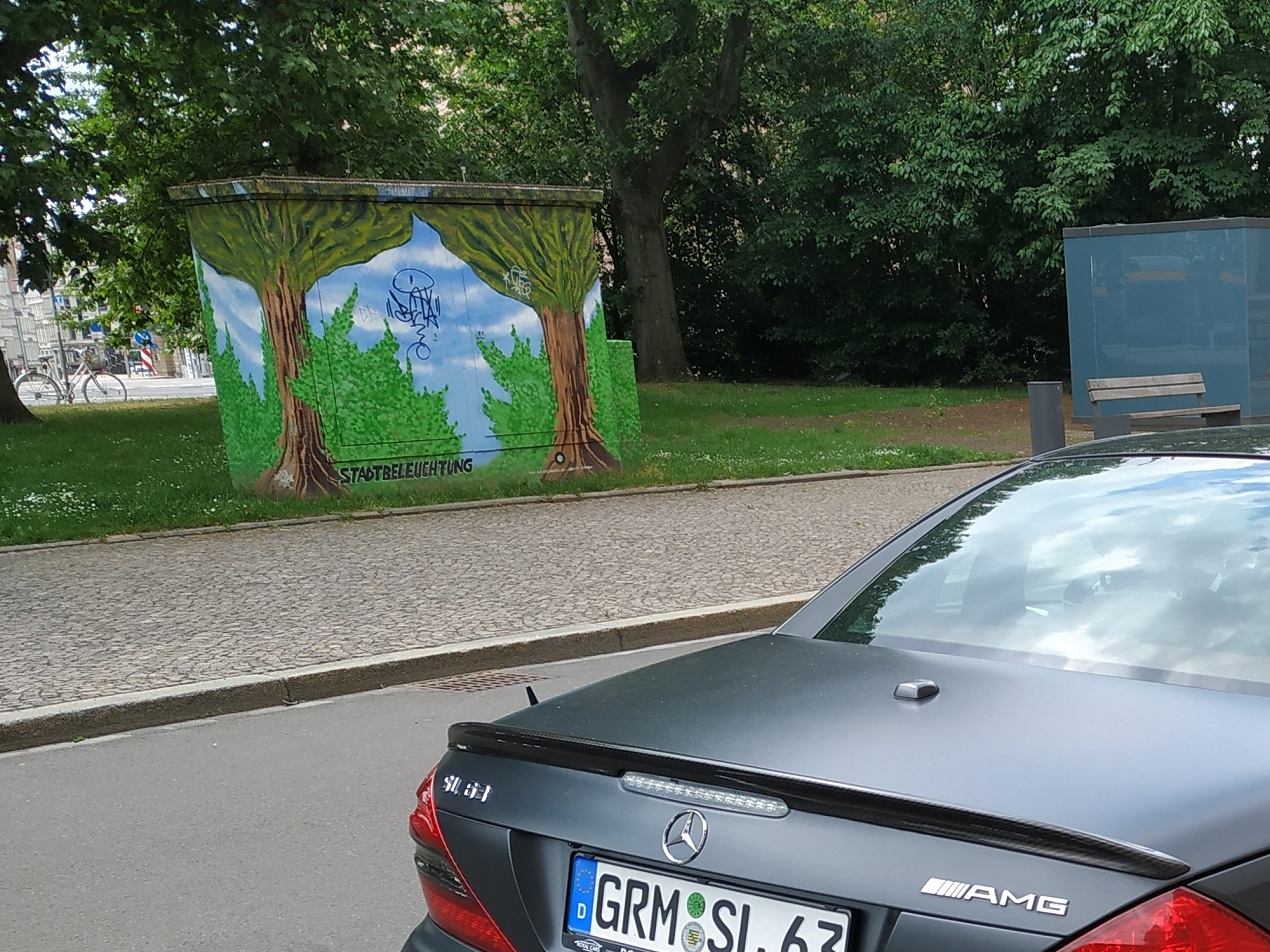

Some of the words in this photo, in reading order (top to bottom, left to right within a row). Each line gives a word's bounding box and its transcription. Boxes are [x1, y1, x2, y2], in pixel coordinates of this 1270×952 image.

[339, 458, 473, 485] STADTBELEUCHTUNG
[577, 903, 587, 919] D
[596, 873, 680, 946] GRM
[964, 884, 1070, 916] AMG
